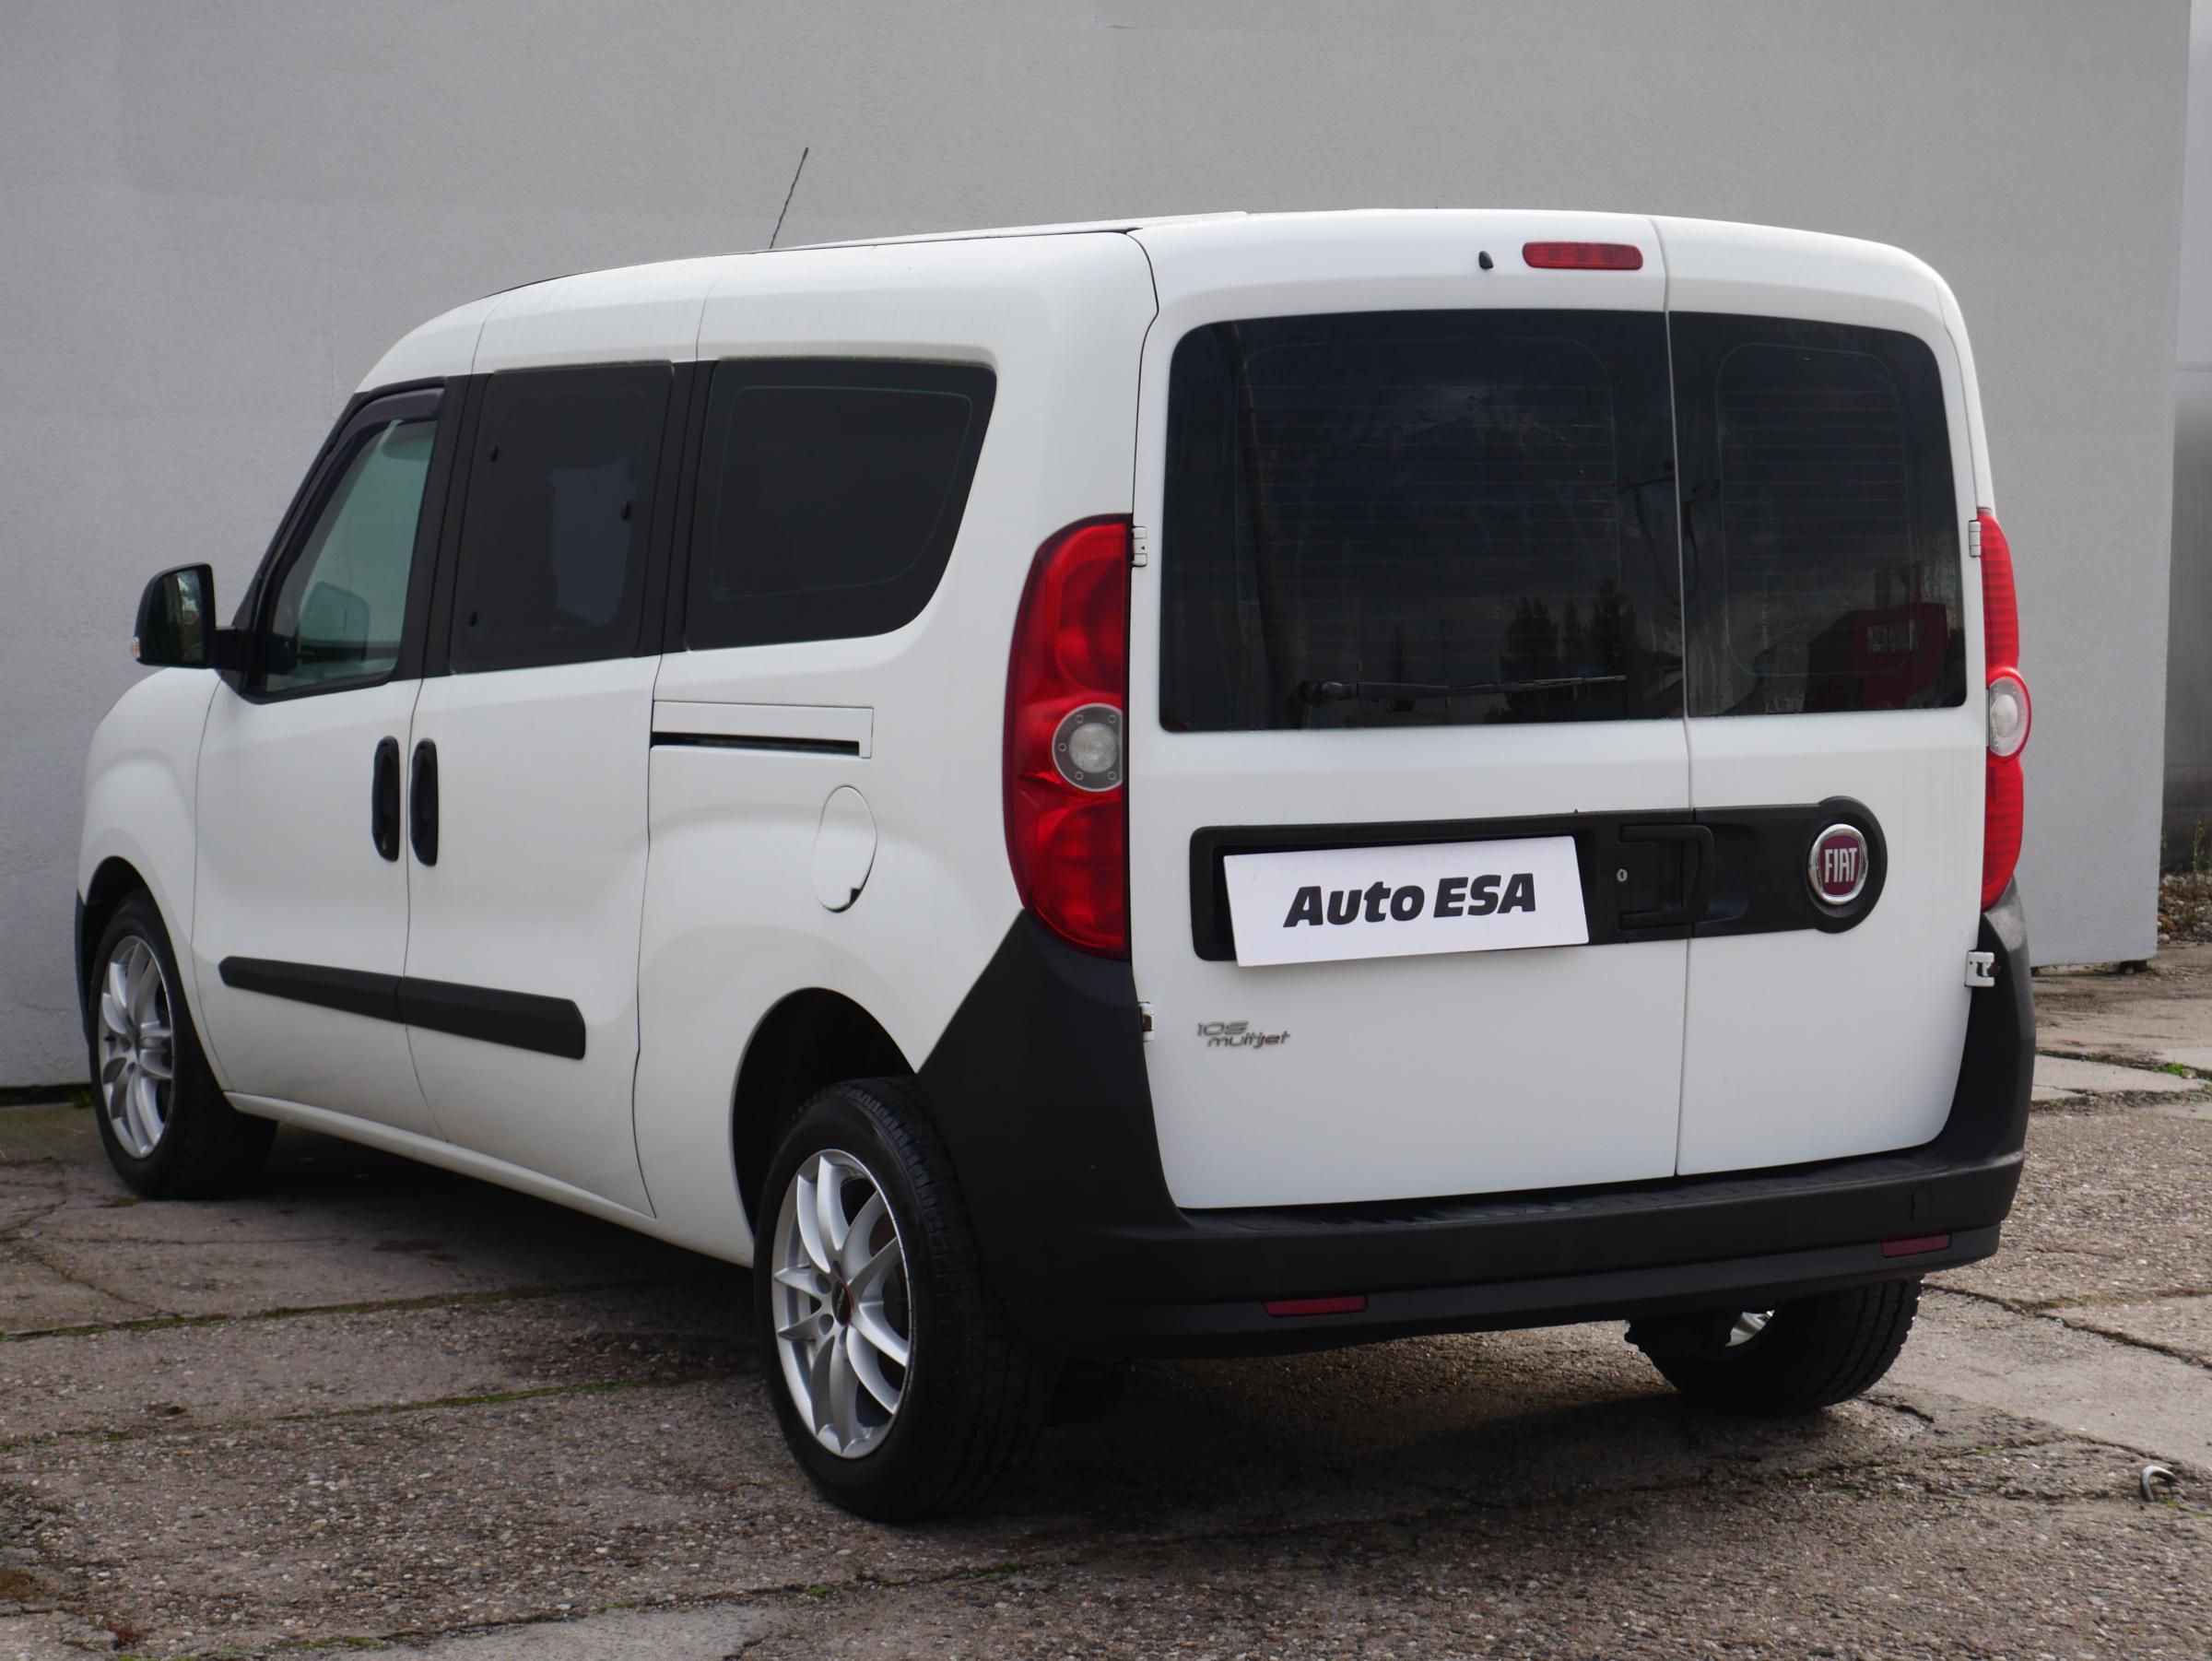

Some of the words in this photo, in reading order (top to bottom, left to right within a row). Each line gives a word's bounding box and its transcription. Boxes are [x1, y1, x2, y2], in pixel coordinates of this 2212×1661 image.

[1824, 847, 1858, 883] FIAT
[1282, 881, 1426, 927] Auto
[1433, 872, 1536, 918] ESA
